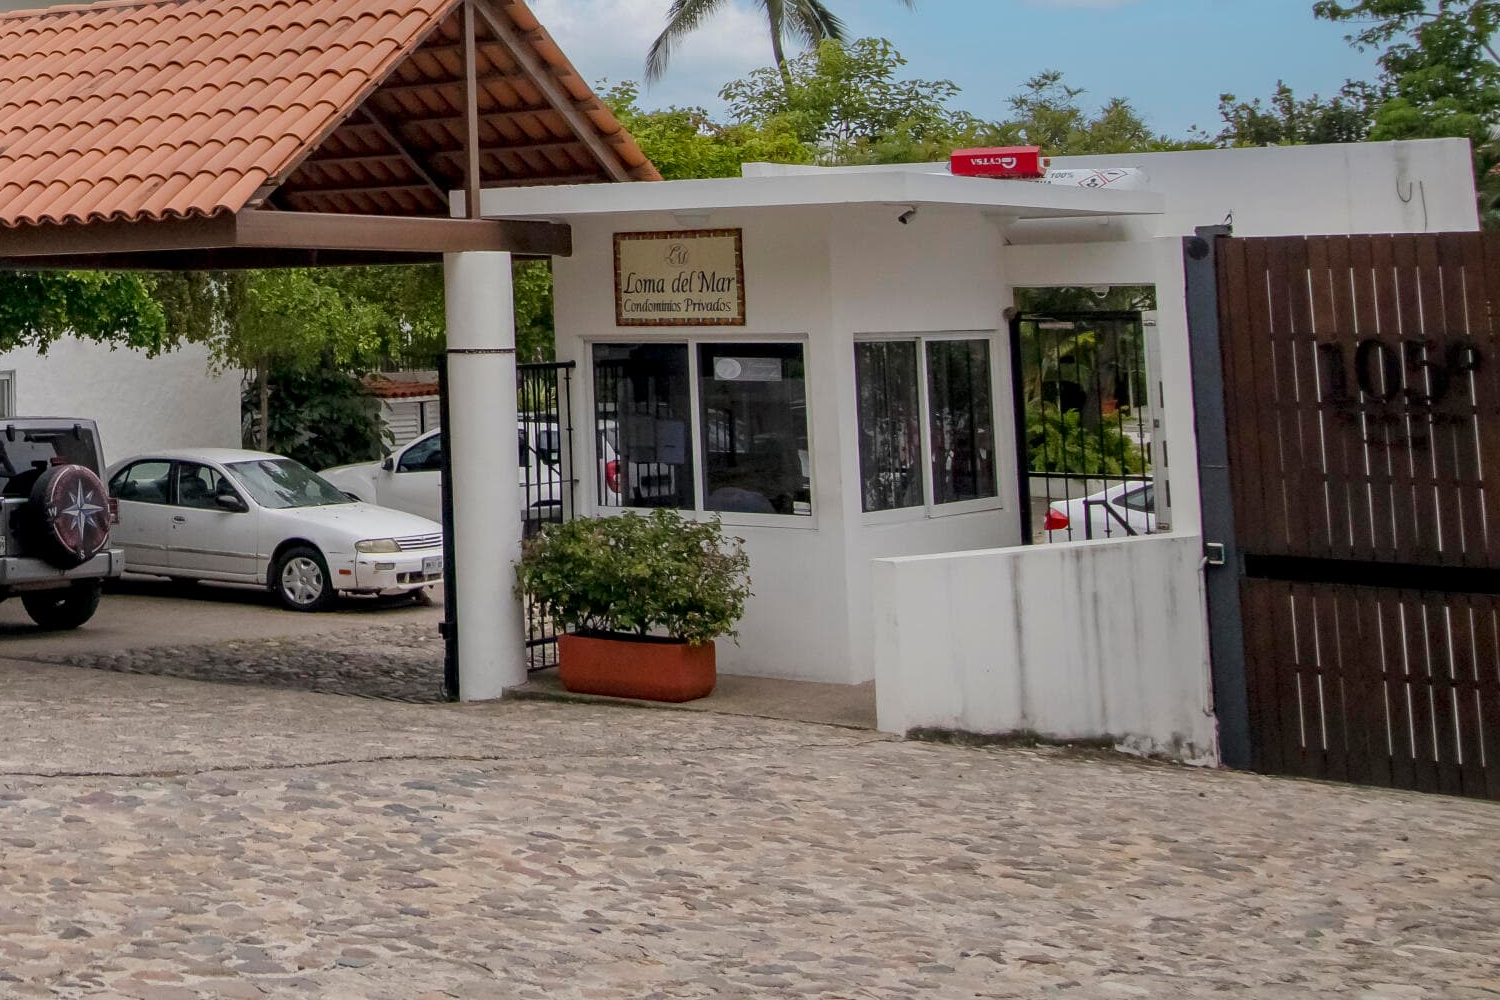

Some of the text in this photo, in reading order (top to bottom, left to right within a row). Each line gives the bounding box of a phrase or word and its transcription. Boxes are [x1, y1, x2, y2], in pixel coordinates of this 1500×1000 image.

[623, 270, 735, 294] Loma del Mar
[623, 298, 732, 313] Condominios Privados
[48, 506, 58, 517] W
[80, 551, 85, 559] S
